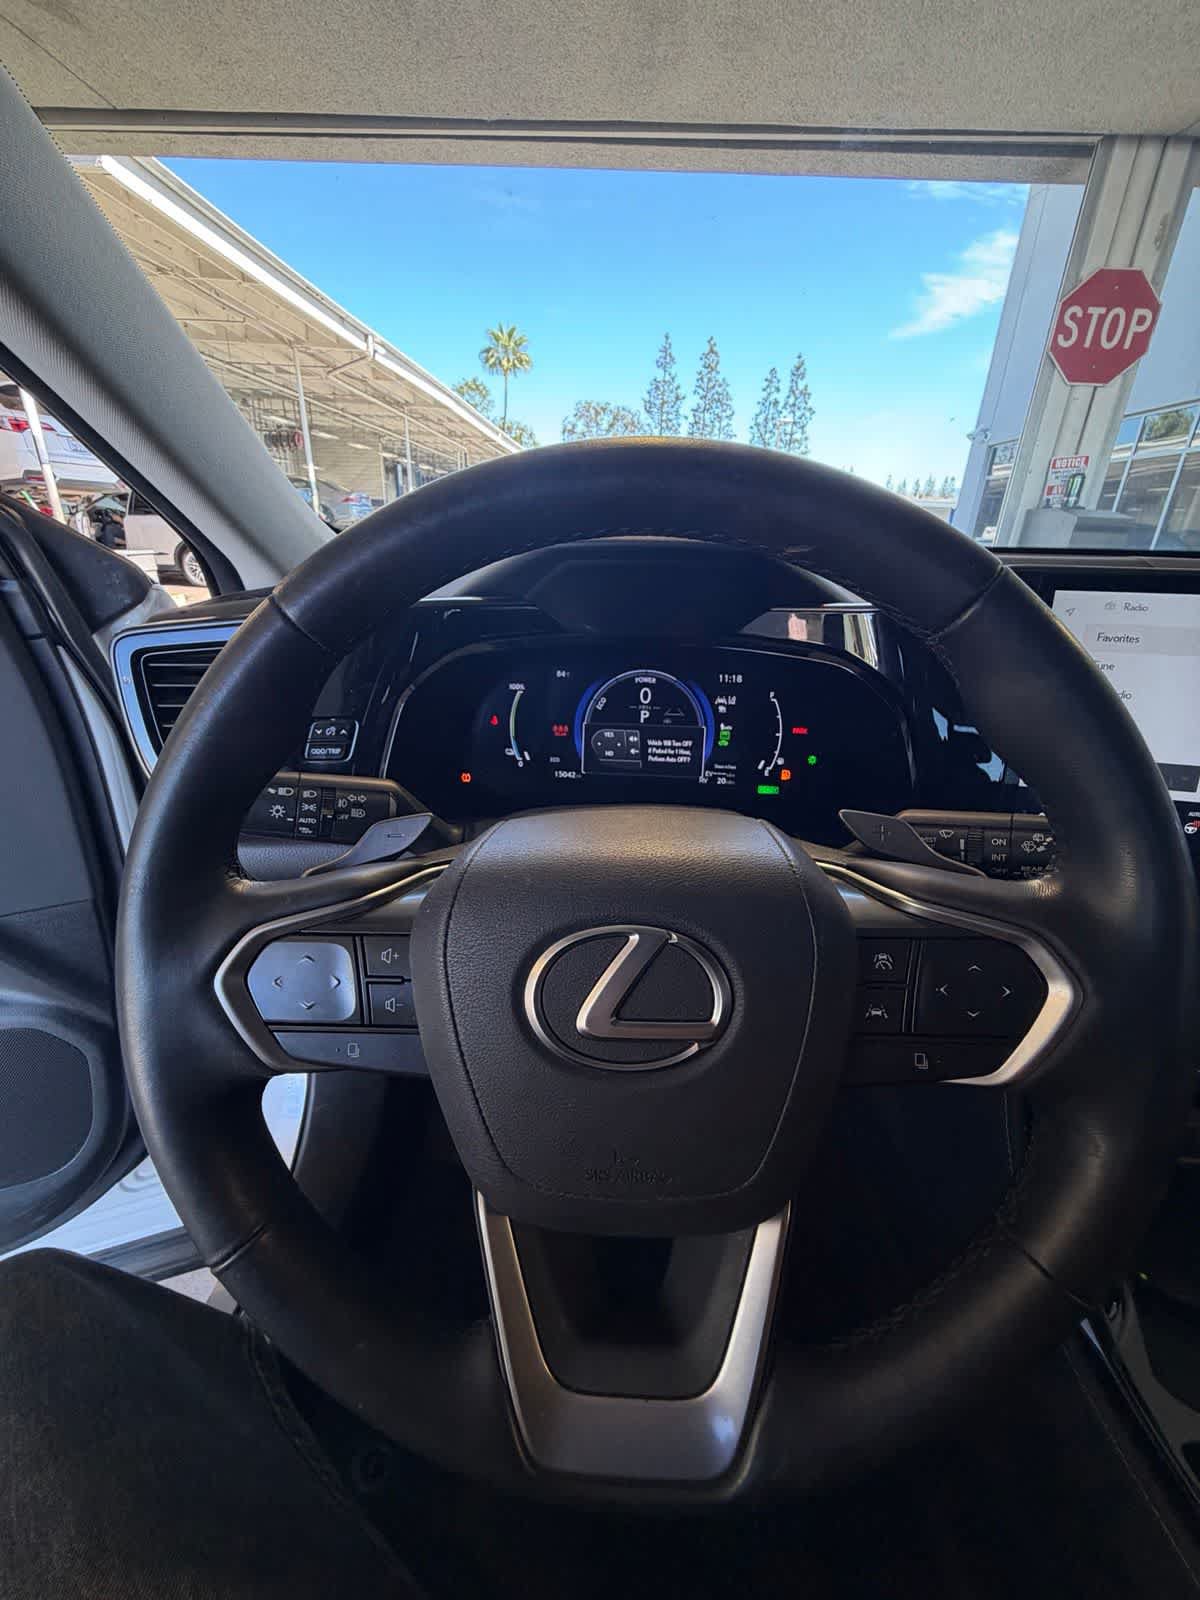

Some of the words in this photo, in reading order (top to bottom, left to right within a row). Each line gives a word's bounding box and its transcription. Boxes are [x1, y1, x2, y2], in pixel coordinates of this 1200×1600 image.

[1057, 305, 1153, 350] STOP
[1123, 602, 1149, 612] Radio
[1096, 632, 1140, 644] Favorites
[1096, 660, 1115, 671] une
[634, 677, 656, 685] POWER
[718, 674, 743, 683] 11:18
[639, 687, 652, 705] 0
[640, 710, 650, 723] P
[298, 816, 317, 824] AUTO
[991, 838, 1007, 846] ON
[991, 854, 1007, 862] INT
